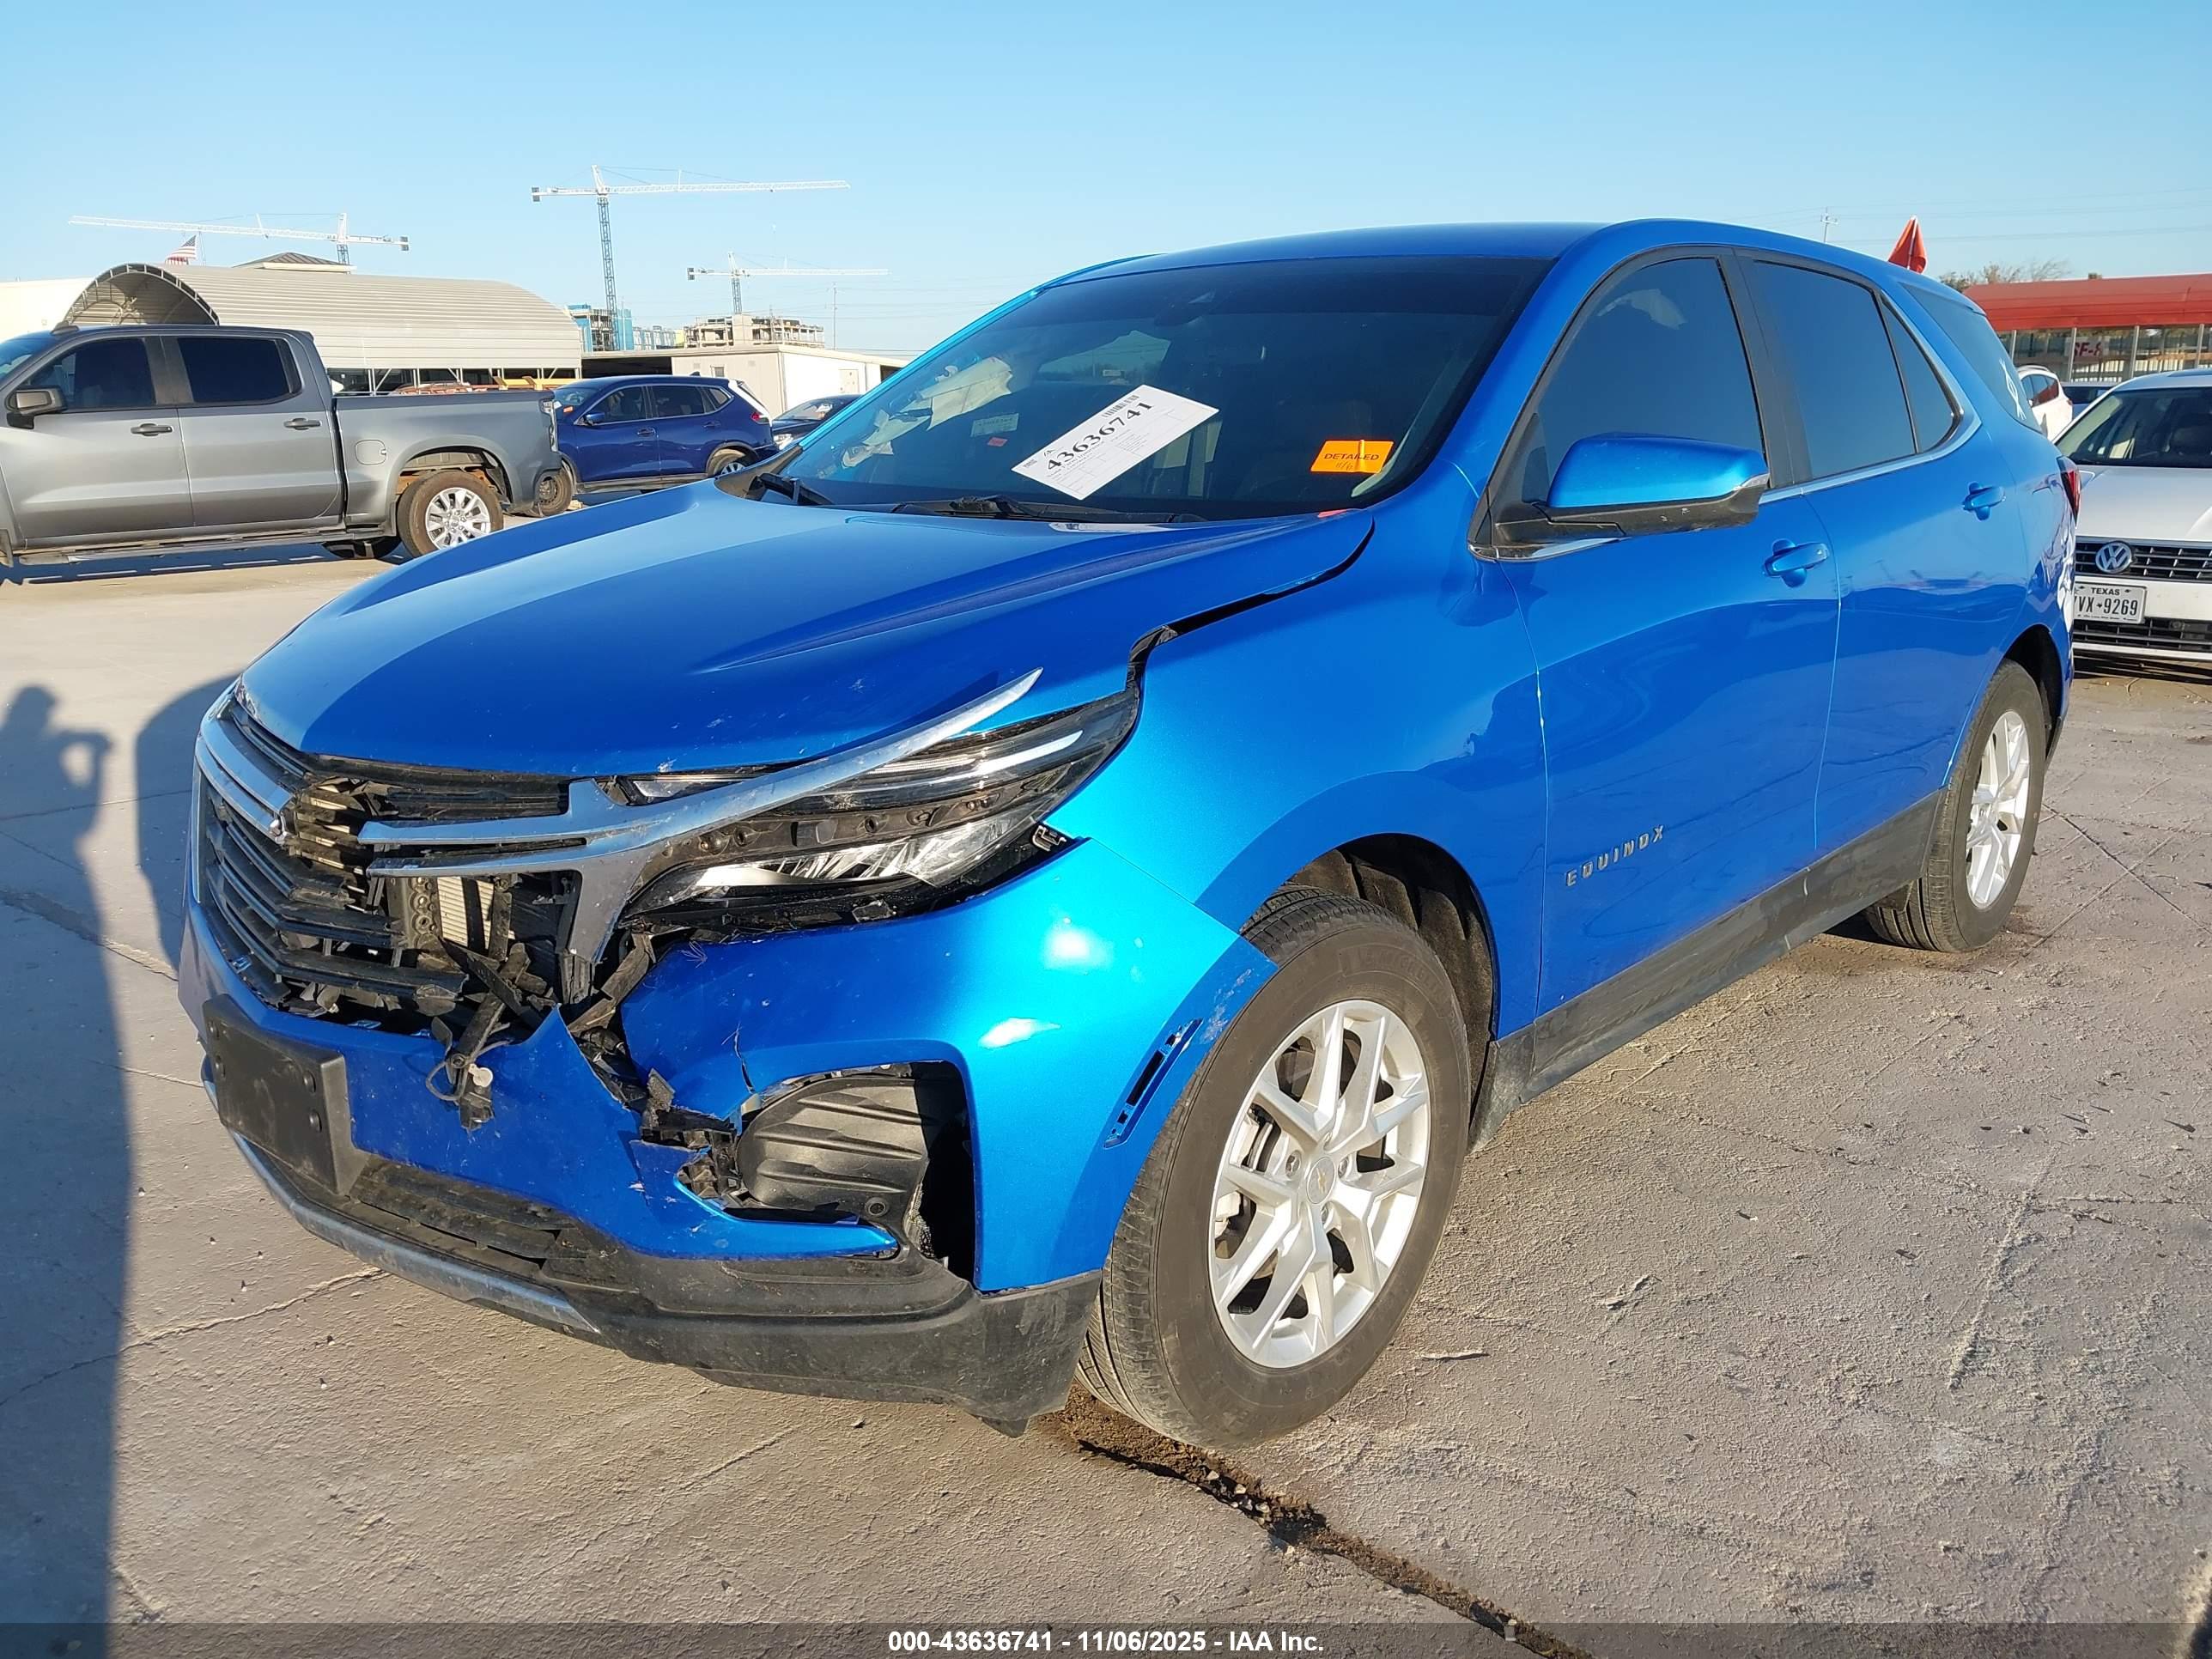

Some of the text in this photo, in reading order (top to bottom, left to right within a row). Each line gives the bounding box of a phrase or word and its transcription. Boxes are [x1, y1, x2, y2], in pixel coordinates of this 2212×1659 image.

[1048, 402, 1154, 470] 43636741
[2090, 586, 2120, 596] TEXAS
[2103, 598, 2138, 616] 9269
[1565, 824, 1664, 887] EQUINOX
